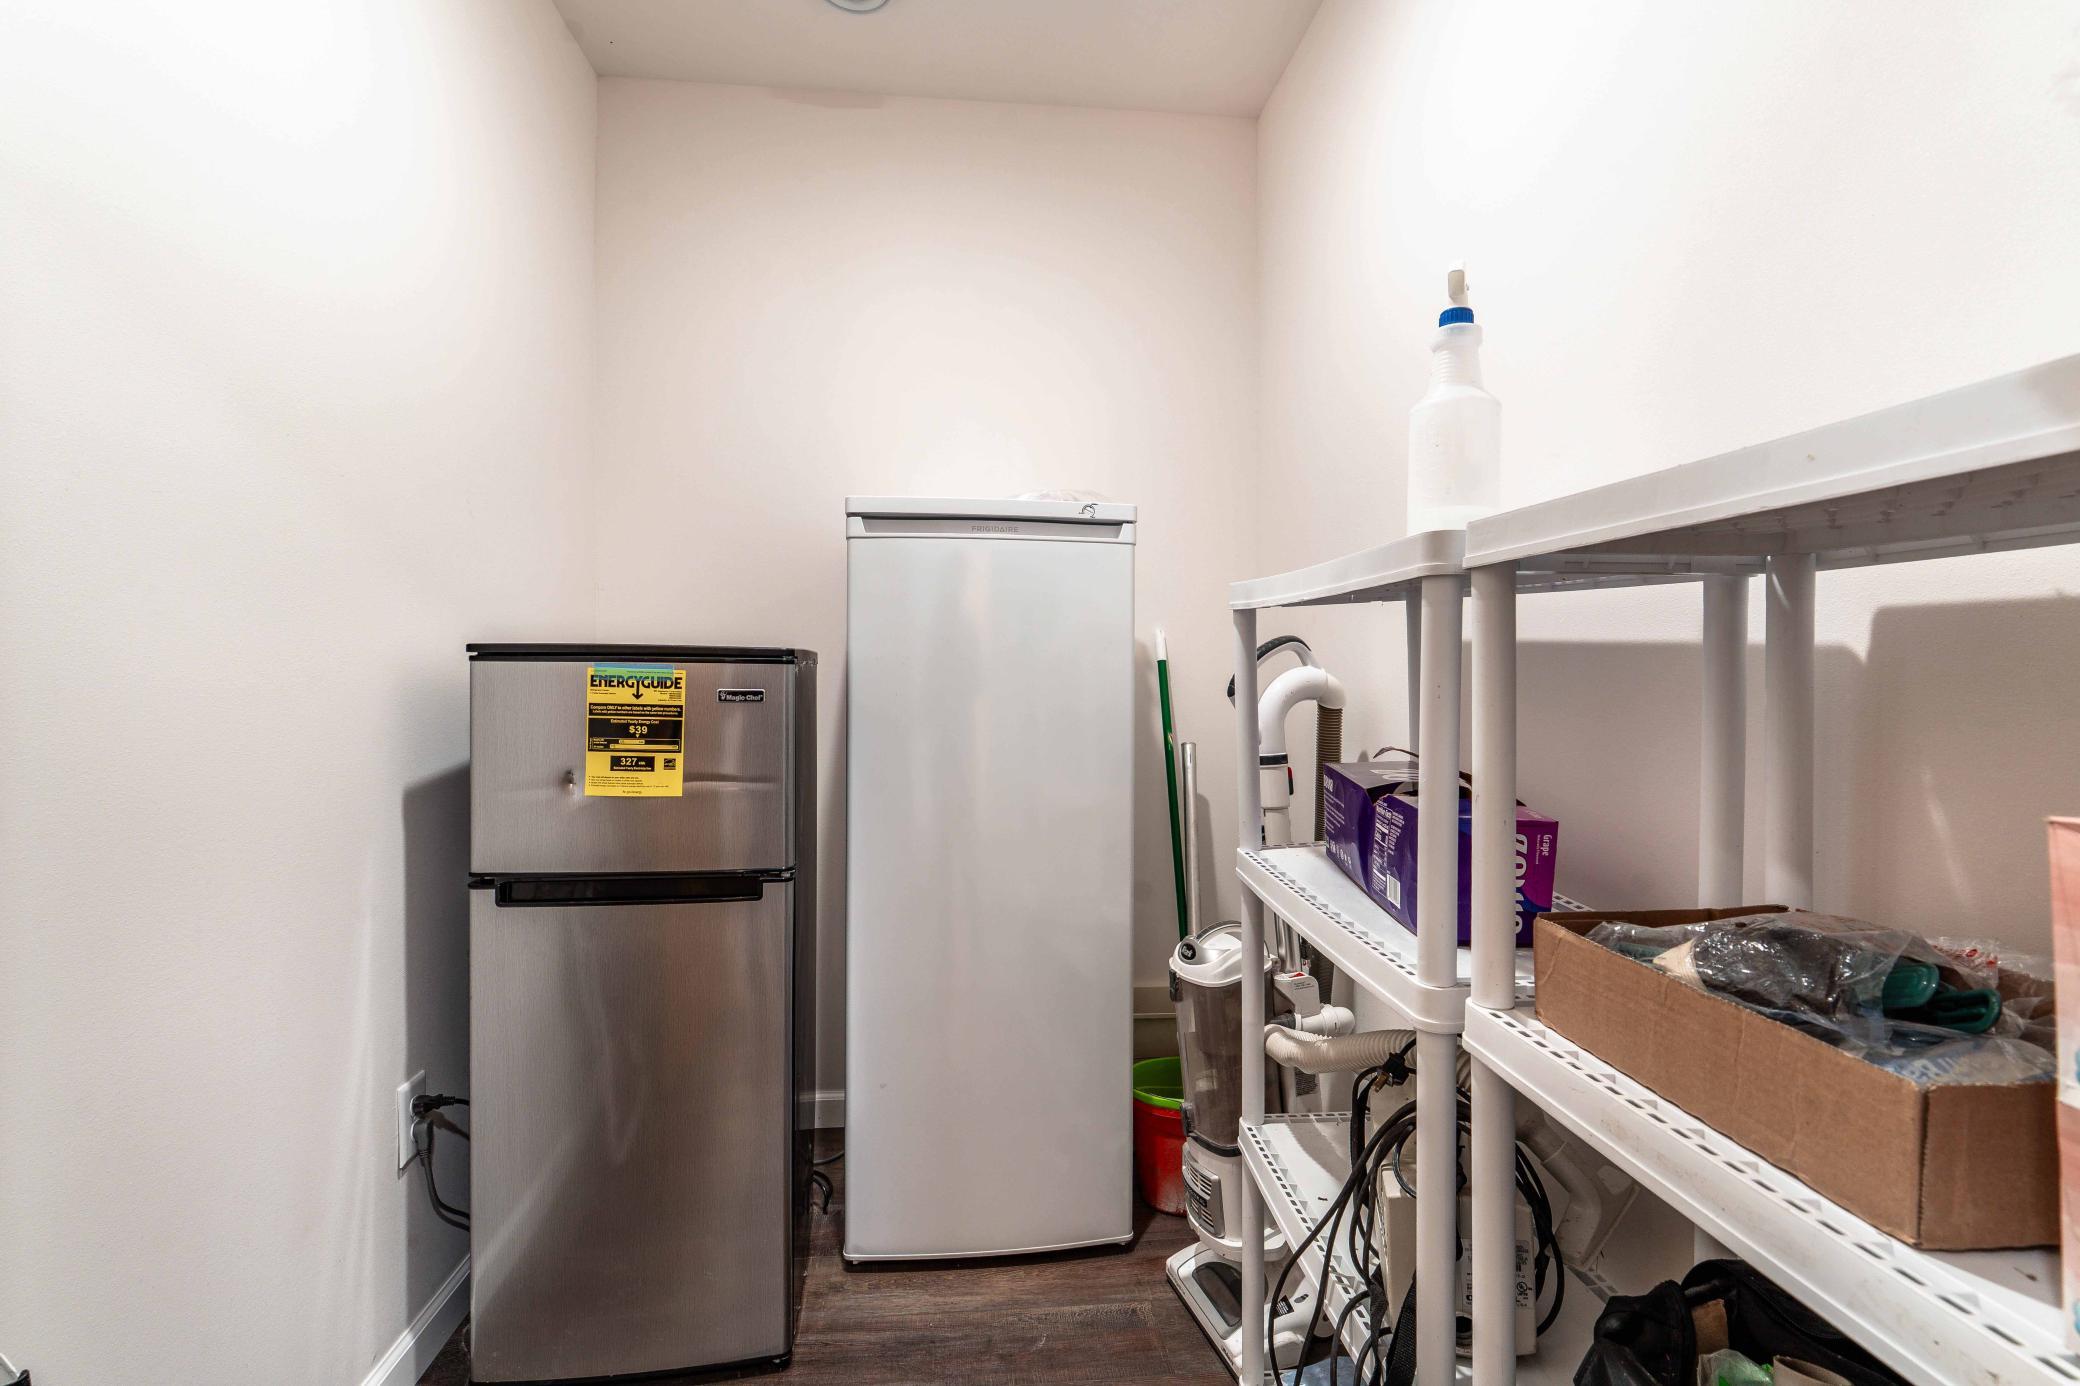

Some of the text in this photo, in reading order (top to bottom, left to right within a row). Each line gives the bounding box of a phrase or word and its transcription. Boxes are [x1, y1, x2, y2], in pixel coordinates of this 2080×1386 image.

[971, 525, 1020, 533] FRIGIDAIRE
[590, 674, 683, 690] ENERGYGUIDE
[628, 725, 648, 734] $39
[620, 757, 638, 766] 327
[1540, 834, 1552, 856] Grape
